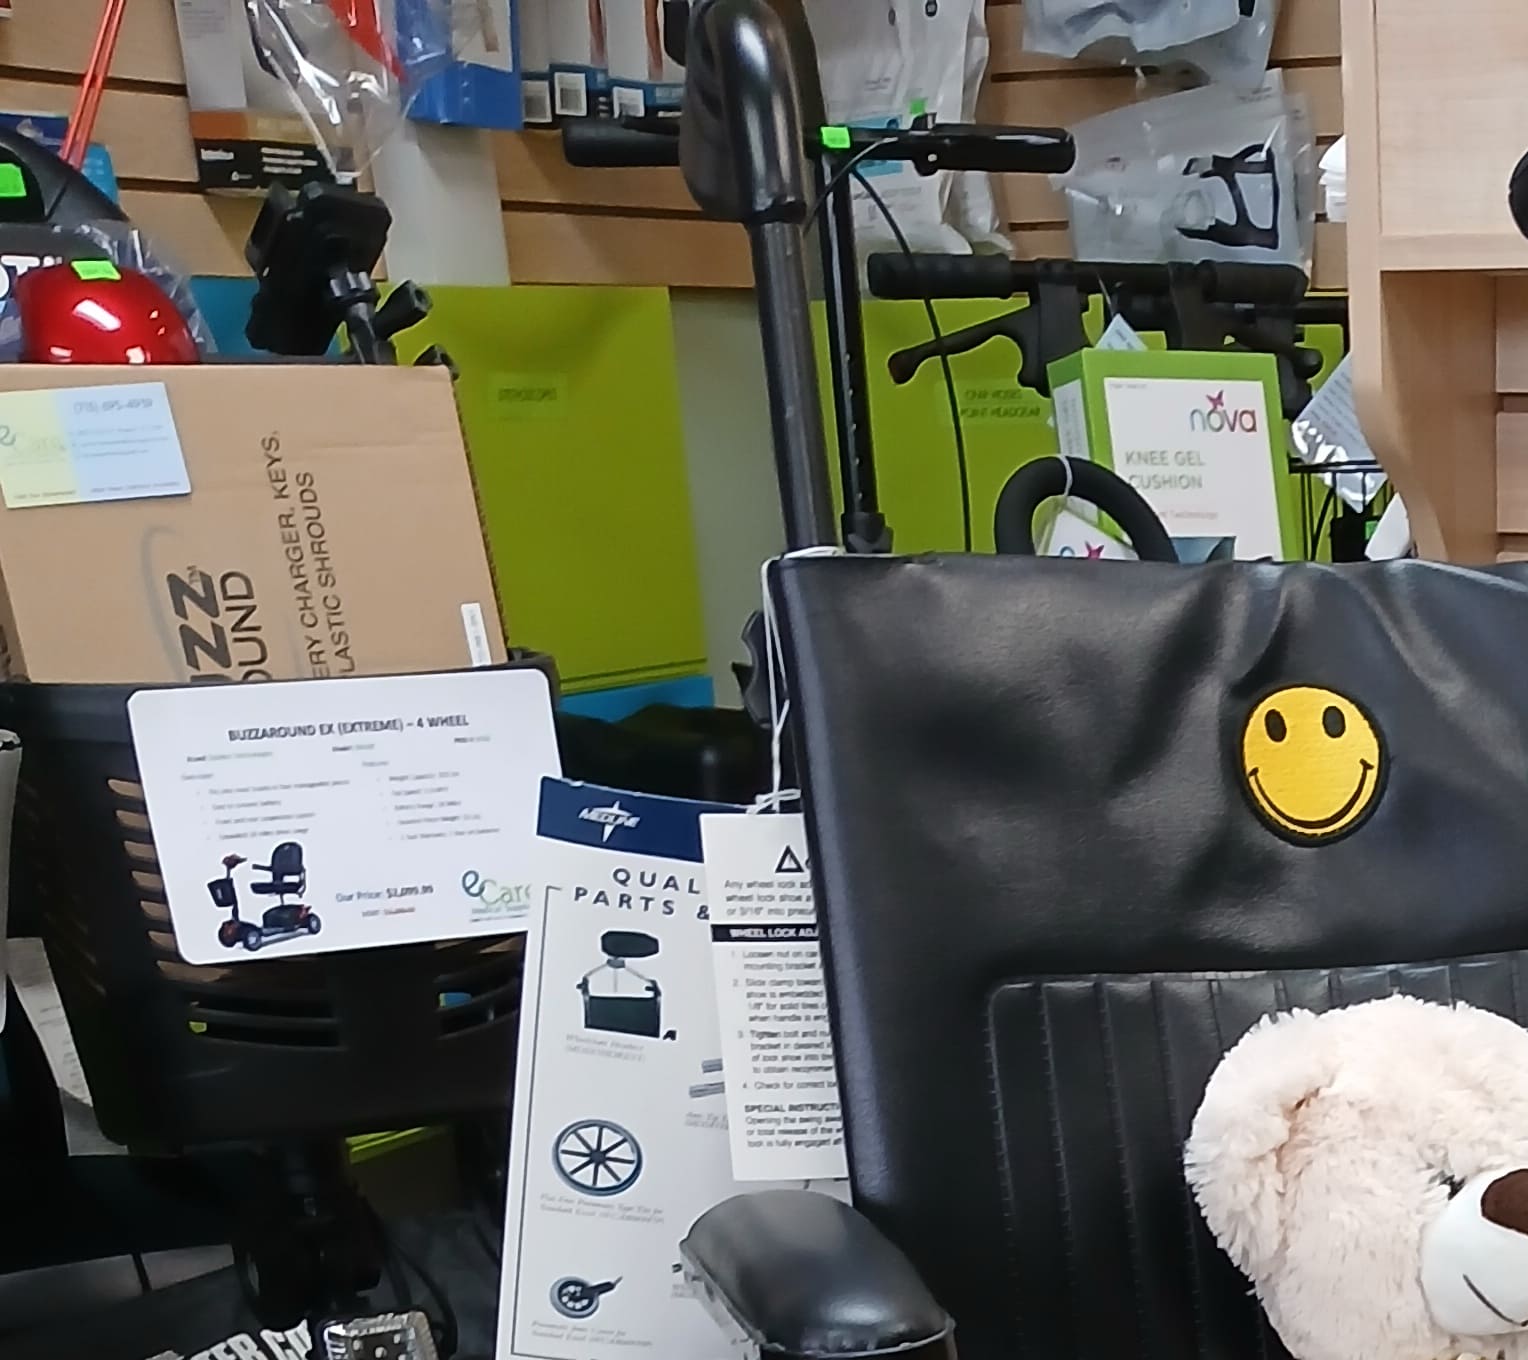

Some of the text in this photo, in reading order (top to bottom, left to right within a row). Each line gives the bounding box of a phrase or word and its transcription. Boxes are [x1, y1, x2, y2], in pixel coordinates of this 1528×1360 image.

[1189, 408, 1258, 433] nova
[1125, 450, 1206, 466] KNEE GEL
[1129, 474, 1203, 490] CUSHION
[295, 472, 356, 680] LASTIC SHROUDS
[228, 725, 316, 741] BUZZAROUND
[319, 723, 334, 736] EX
[337, 717, 405, 737] (EXTREME)
[416, 717, 425, 729] 4
[427, 716, 469, 729] WHEEL
[612, 867, 702, 895] QUAL
[573, 886, 711, 921] PARTS &
[798, 928, 819, 938] ADJ
[788, 1102, 841, 1112] INSTRUCTI
